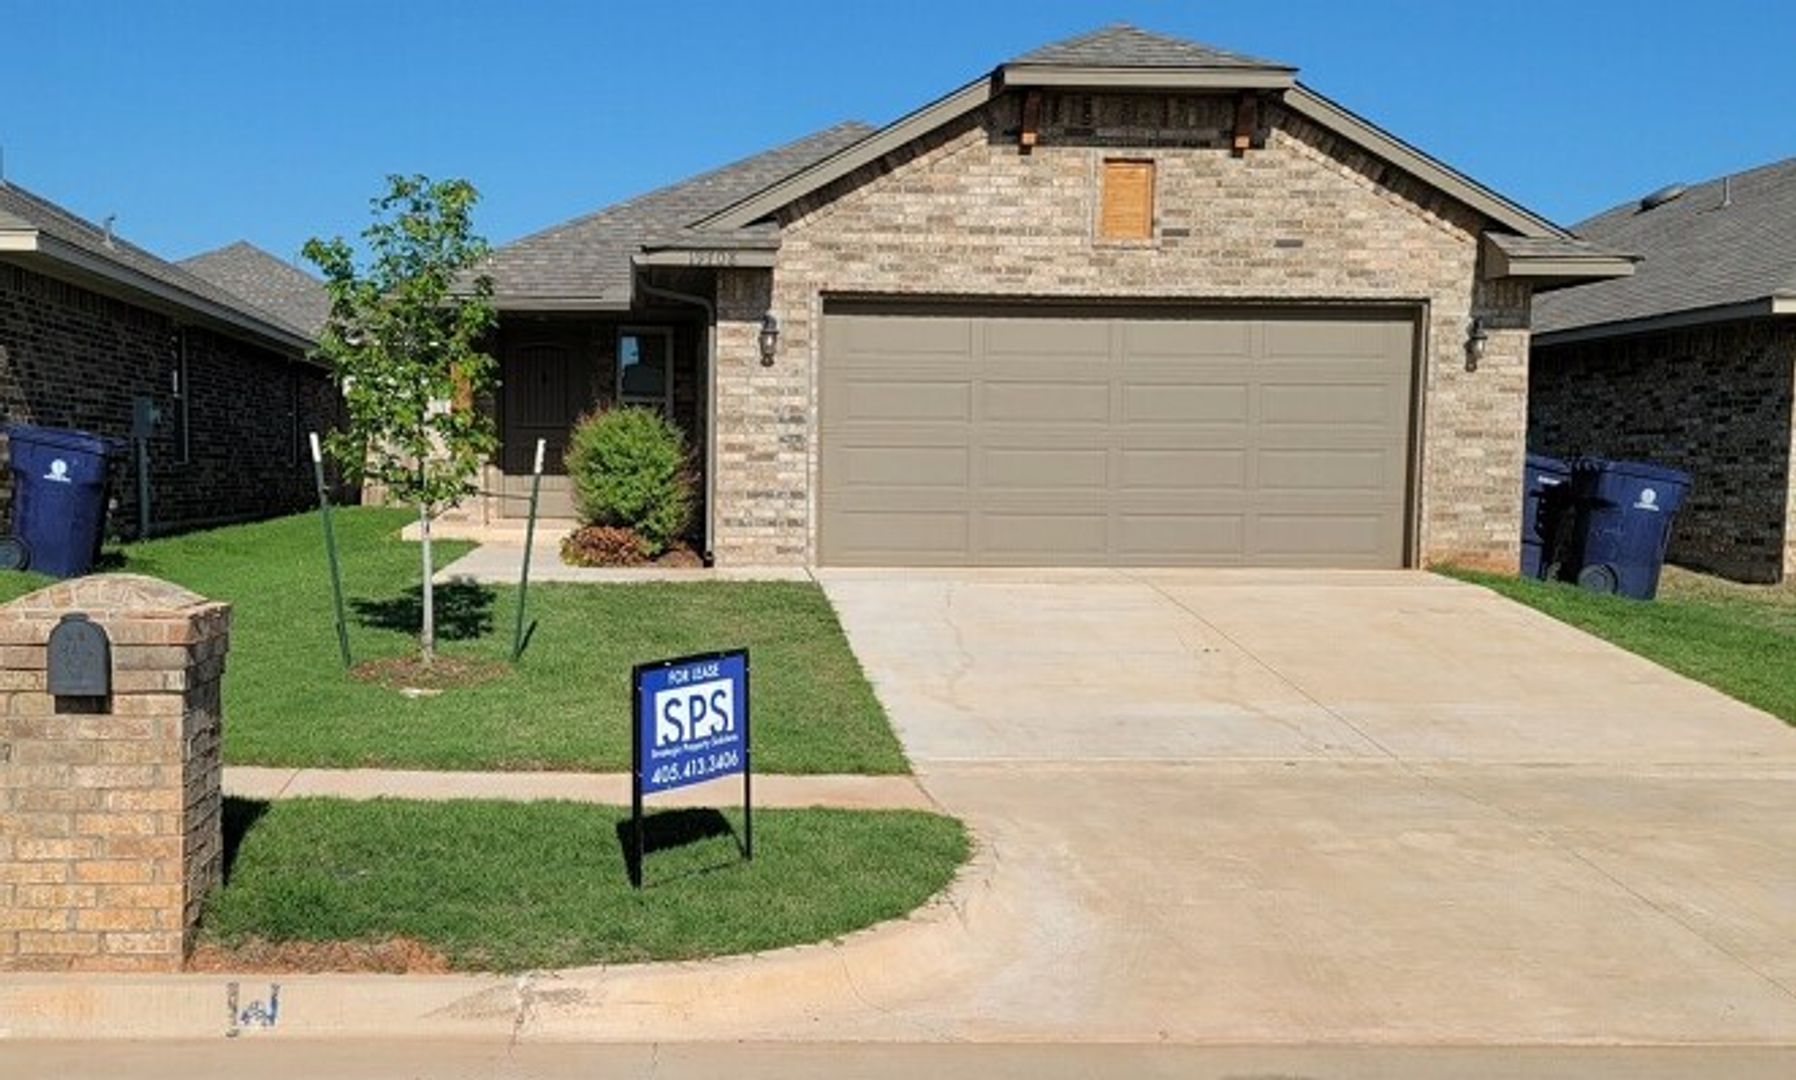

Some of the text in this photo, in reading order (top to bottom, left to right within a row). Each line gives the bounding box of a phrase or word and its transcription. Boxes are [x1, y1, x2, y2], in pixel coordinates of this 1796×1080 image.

[668, 662, 719, 685] FOR LEASE
[662, 689, 729, 745] SPS
[683, 741, 710, 751] Property
[651, 749, 739, 783] 405.413.3406
